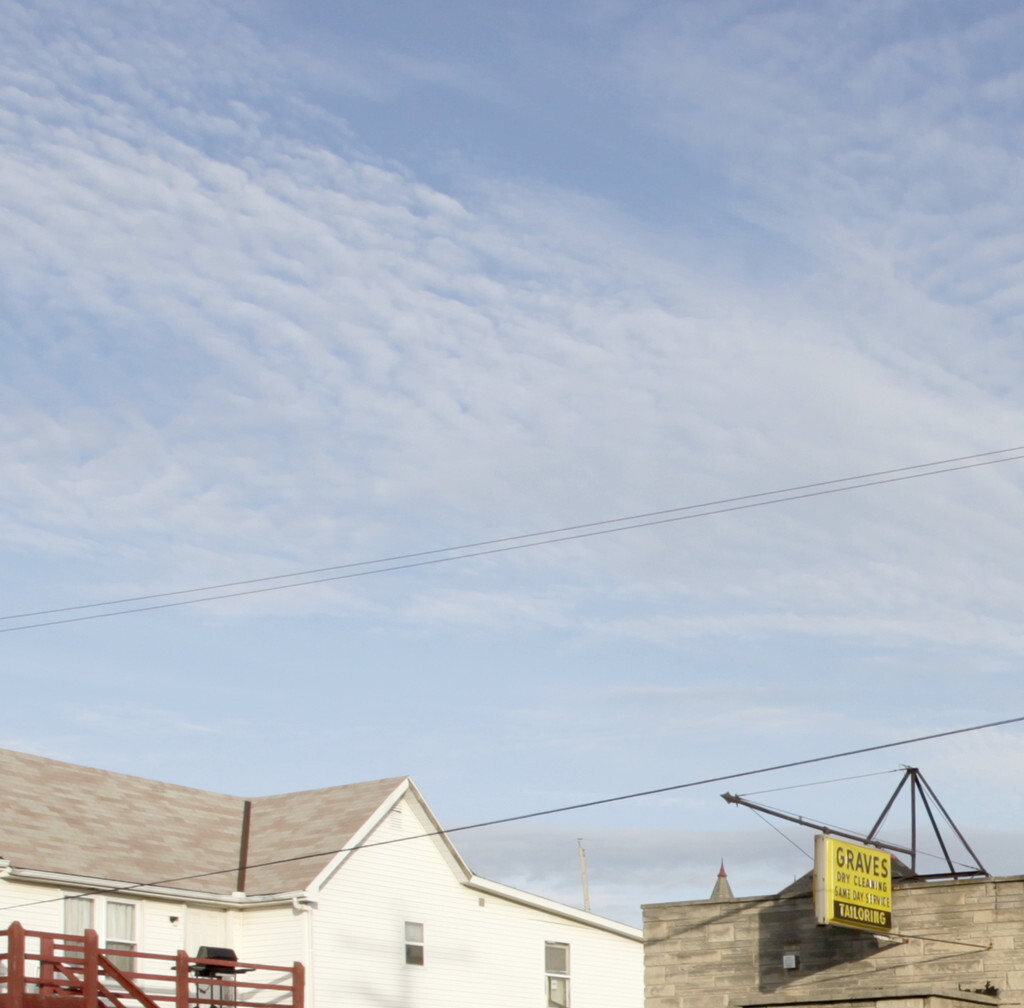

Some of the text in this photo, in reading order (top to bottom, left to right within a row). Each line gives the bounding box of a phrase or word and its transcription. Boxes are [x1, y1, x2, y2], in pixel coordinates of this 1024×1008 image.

[836, 846, 889, 878] GRAVES
[836, 871, 887, 892] DRY CLEANING
[835, 886, 890, 908] SAME DAY SERVICE
[839, 903, 886, 925] TAILORING
